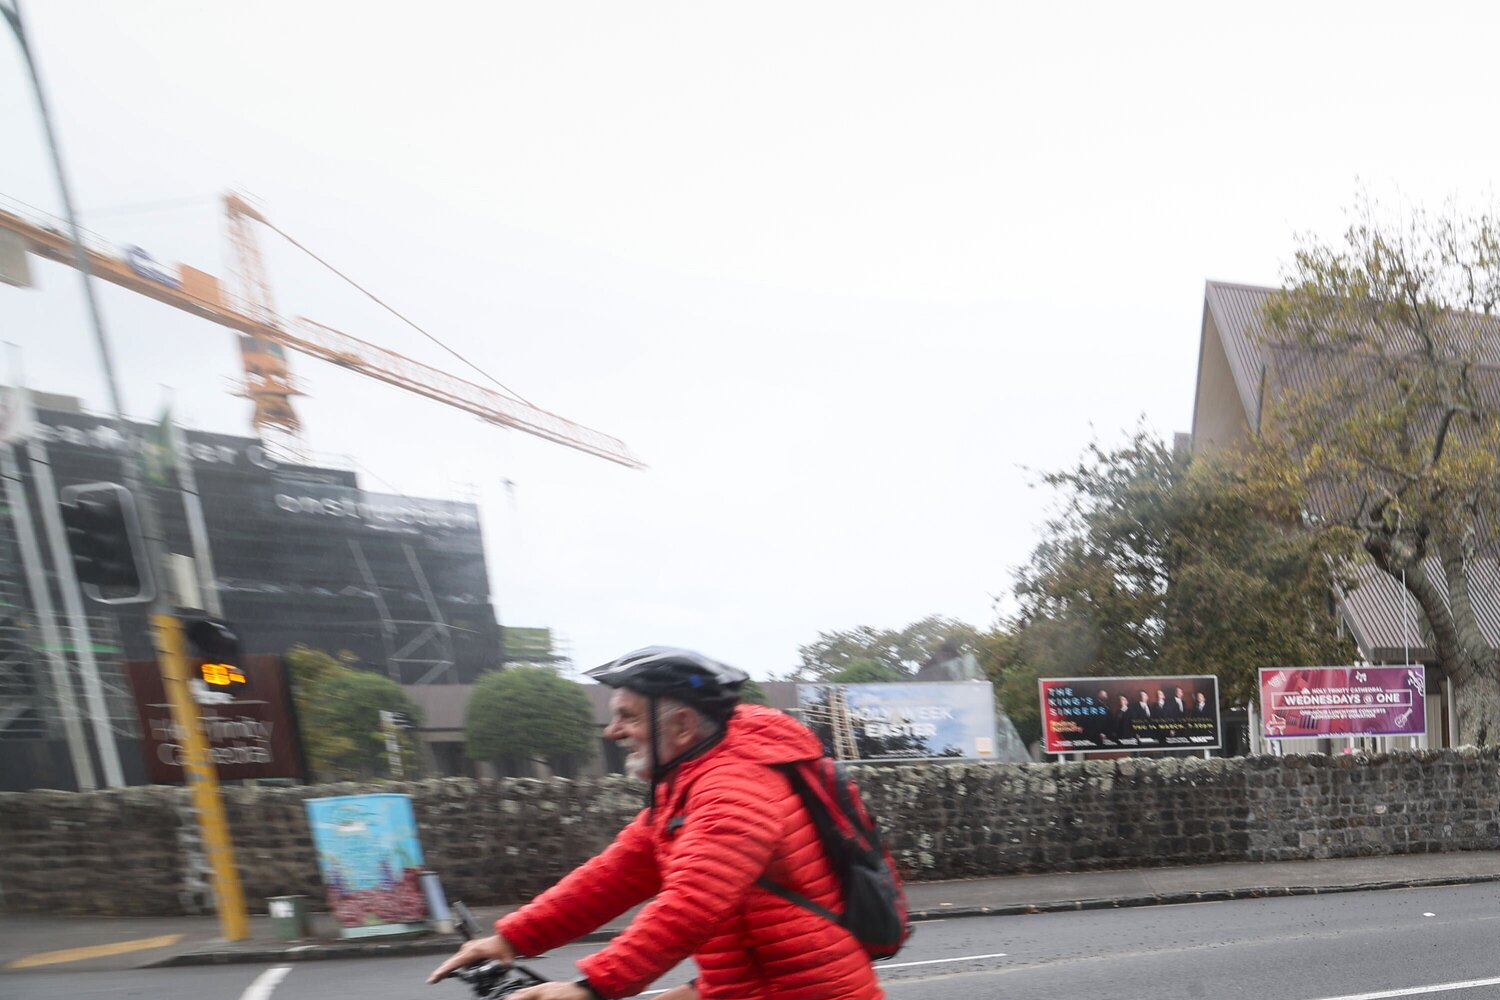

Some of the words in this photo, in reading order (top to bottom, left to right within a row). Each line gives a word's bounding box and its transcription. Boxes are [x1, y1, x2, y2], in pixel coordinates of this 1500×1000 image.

[1048, 687, 1073, 697] THE
[1048, 696, 1094, 707] KING'S
[1284, 694, 1361, 706] WEDNESDAYS
[1363, 693, 1374, 705] @
[1376, 692, 1400, 703] ONE
[1049, 706, 1107, 717] SINGERS
[863, 722, 937, 738] EASTER
